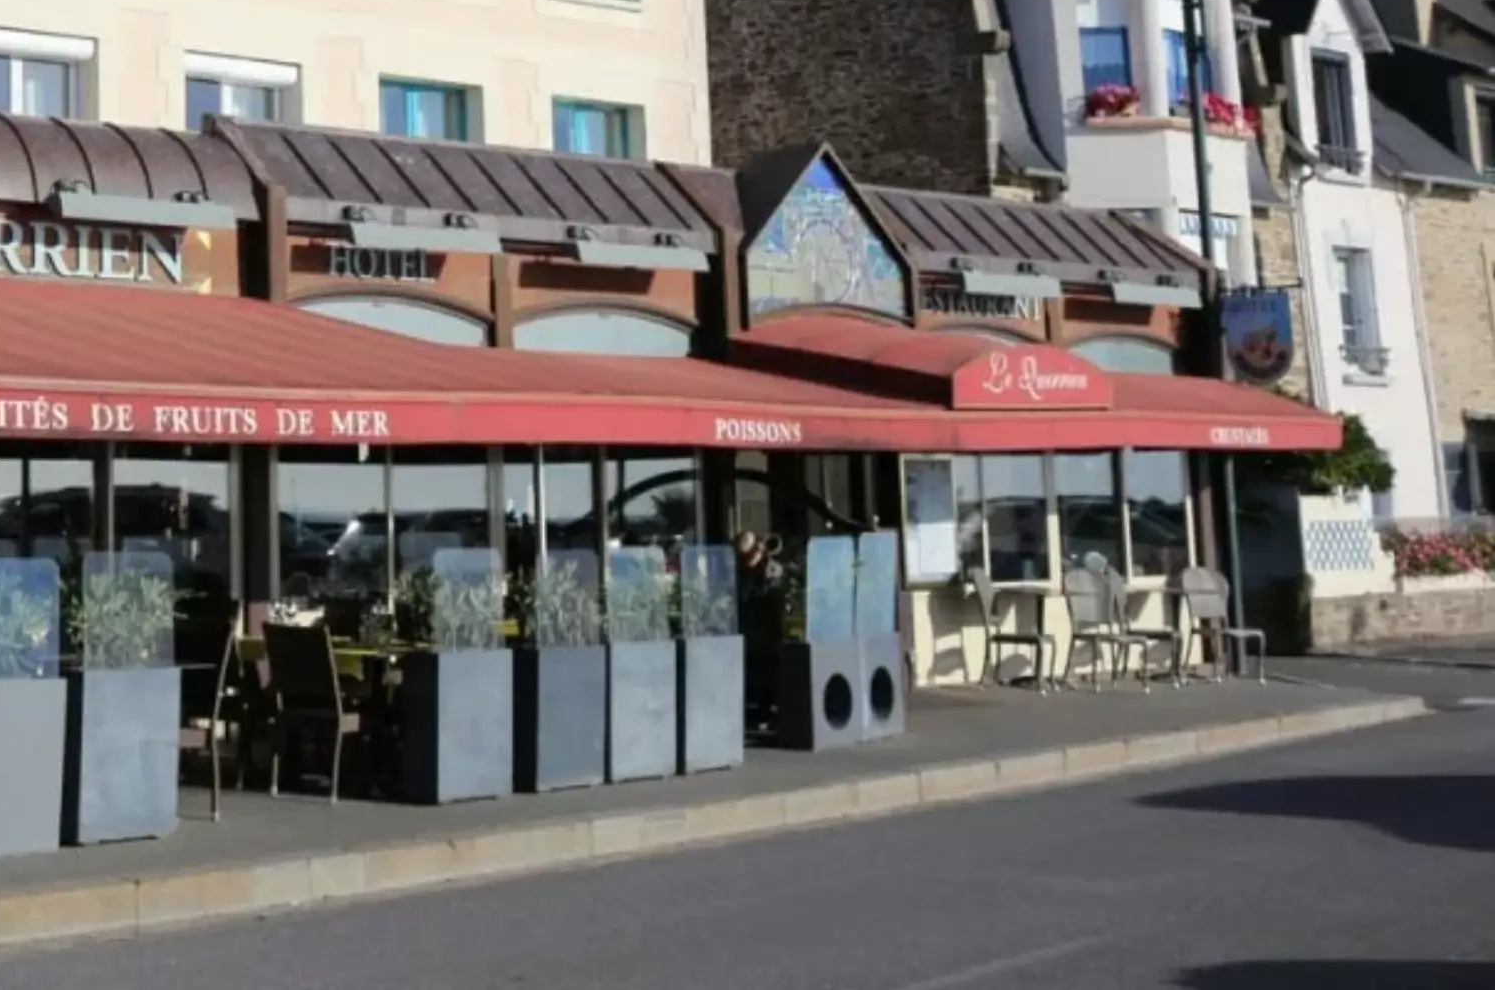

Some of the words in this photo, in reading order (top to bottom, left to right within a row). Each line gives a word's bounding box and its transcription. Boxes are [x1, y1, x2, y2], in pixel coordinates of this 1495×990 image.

[328, 246, 436, 283] HOTEL
[91, 405, 133, 432] DE
[155, 406, 257, 434] FRUITS
[277, 409, 313, 435] DE
[331, 410, 390, 436] MER
[715, 418, 802, 444] POISSONS
